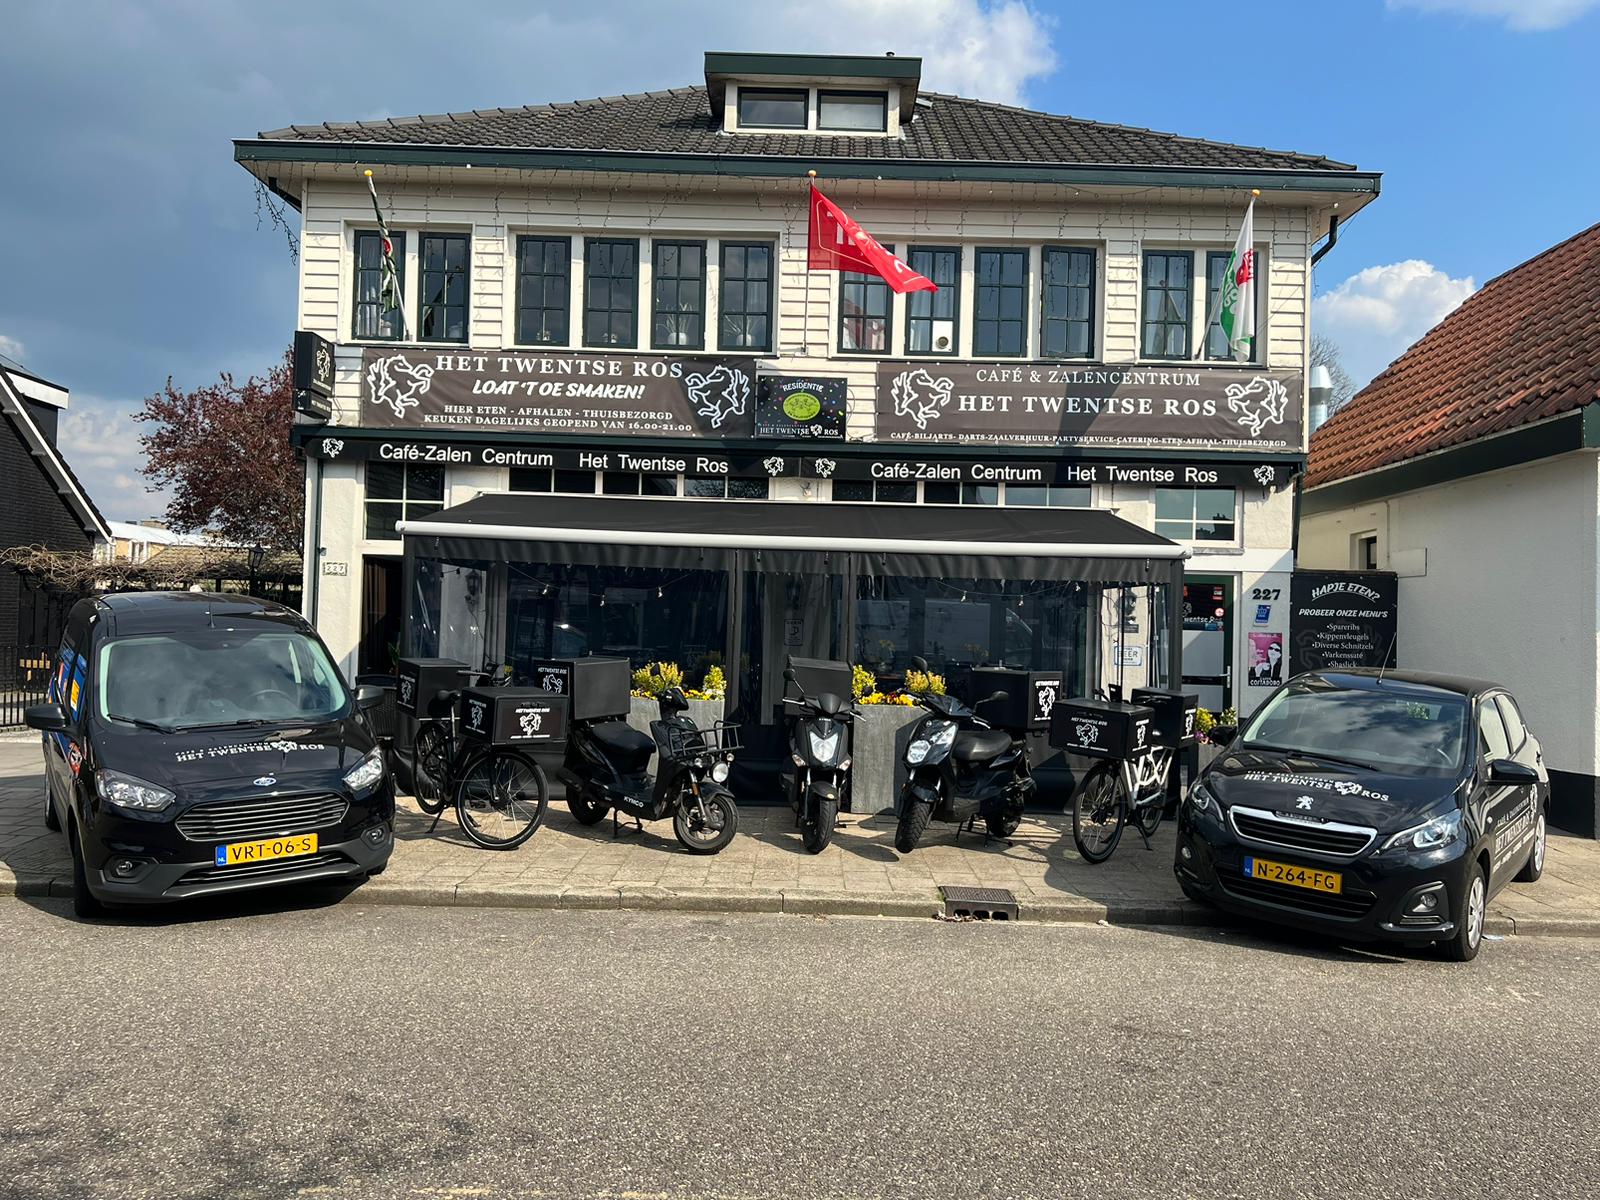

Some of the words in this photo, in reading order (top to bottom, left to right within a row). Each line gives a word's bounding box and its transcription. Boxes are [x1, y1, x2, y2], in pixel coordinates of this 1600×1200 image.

[435, 355, 488, 372] HET
[498, 357, 622, 376] TWENTSE
[633, 361, 683, 378] ROS
[976, 368, 1023, 383] CAFÉ
[1029, 370, 1041, 383] &
[1048, 370, 1200, 386] ZALENCENTRUM
[472, 379, 520, 395] LOAT
[538, 382, 564, 397] OE
[566, 383, 645, 400] SMAKEN!
[782, 382, 824, 392] RESIDENTIE
[444, 405, 473, 414] HIER
[477, 406, 507, 415] ETEN
[518, 407, 572, 417] AFHALEN
[583, 409, 673, 420] THUISBEZORGD
[958, 395, 1012, 412] HET
[1022, 396, 1152, 415] TWENTSE
[1164, 398, 1217, 416] ROS
[424, 414, 472, 424] KEUKEN
[475, 416, 540, 426] DAGELIJKS
[543, 418, 598, 428] GEOPEND
[601, 420, 625, 429] VAN
[628, 422, 692, 431] 16.00-21.00
[380, 443, 472, 463] Café-Zalen
[482, 448, 553, 466] Centrum
[579, 453, 608, 469] Het
[617, 454, 686, 471] Twentse
[696, 457, 729, 473] Ros
[871, 462, 961, 480] Café-Zalen
[971, 464, 1042, 481] Centrum
[1067, 466, 1096, 481] Het
[1106, 466, 1175, 482] Twentse
[1185, 467, 1218, 482] Ros
[1252, 588, 1281, 600] 227
[1312, 582, 1346, 598] HAPJE
[1347, 583, 1381, 600] ETEN?
[1299, 608, 1335, 617] PROBEER
[1319, 632, 1369, 640] Kippenvleugels
[1328, 623, 1360, 631] Spareribs
[1314, 641, 1340, 649] Diverse
[1341, 642, 1374, 650] Schnitzels
[177, 752, 204, 762] HET
[208, 746, 272, 758] TWENTSE
[1244, 773, 1270, 781] HET
[1272, 775, 1332, 790] TWENTSE
[1361, 790, 1389, 801] ROS
[232, 838, 311, 860] VRT-06-S
[1258, 862, 1335, 889] N-264-FG
